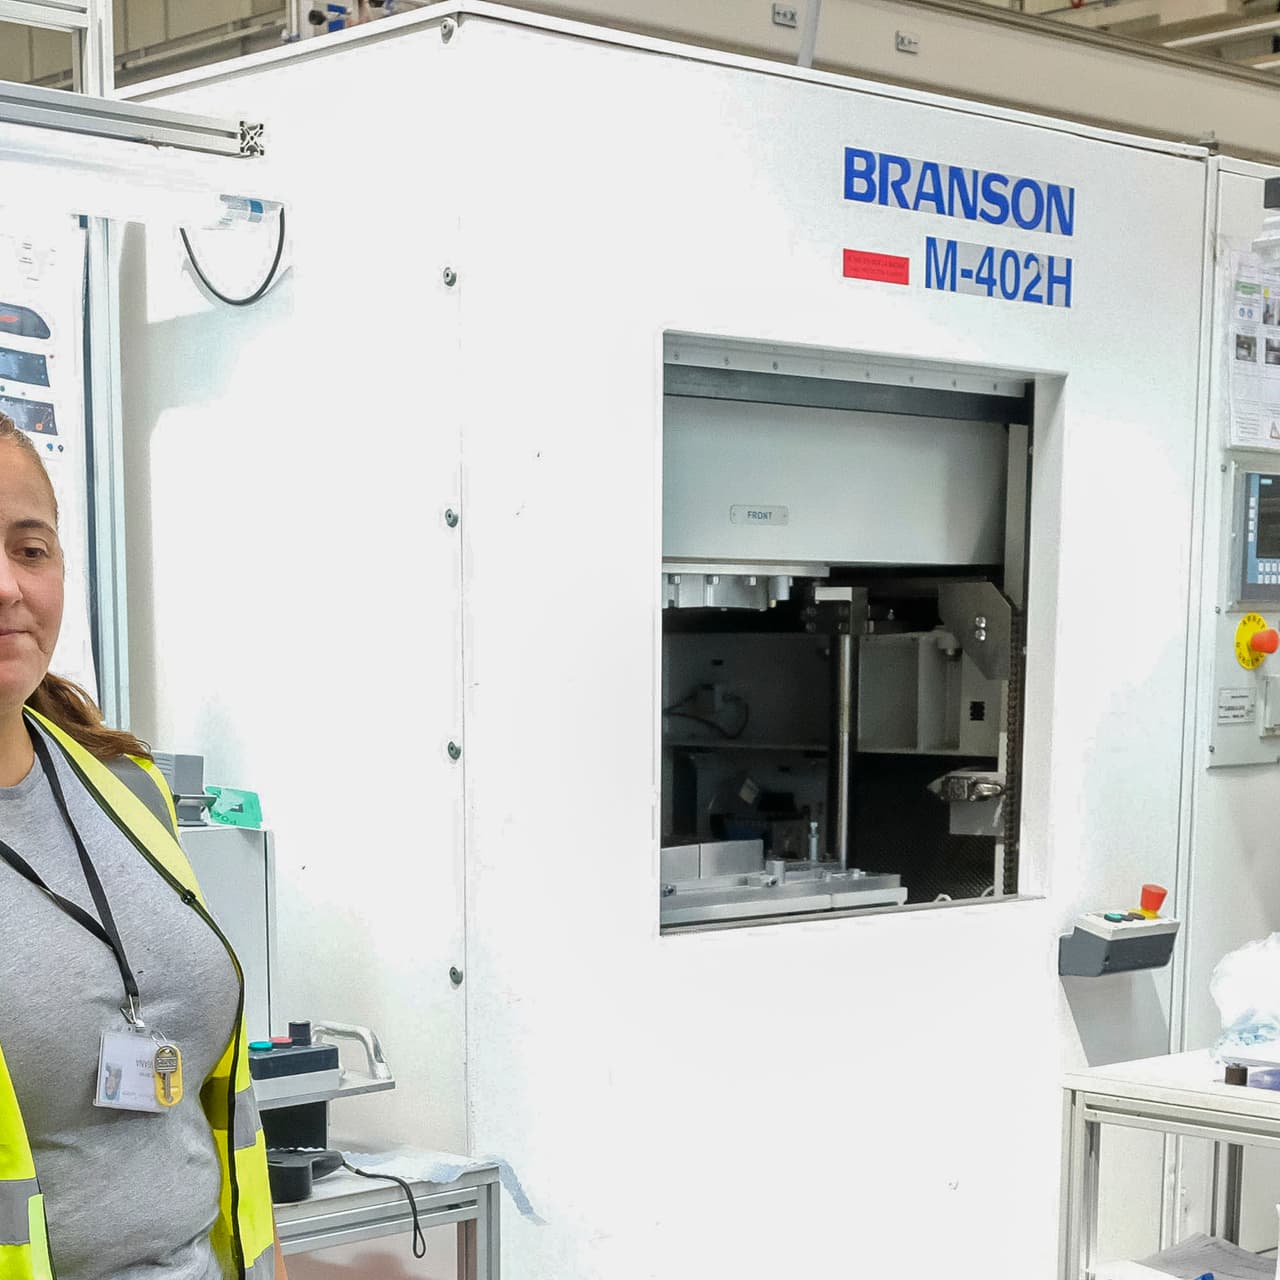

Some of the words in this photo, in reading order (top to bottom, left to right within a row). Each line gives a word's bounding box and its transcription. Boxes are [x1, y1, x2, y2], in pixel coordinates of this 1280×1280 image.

[844, 147, 1075, 237] BRANSON
[925, 236, 1073, 308] M-402H
[747, 510, 773, 521] FRONT
